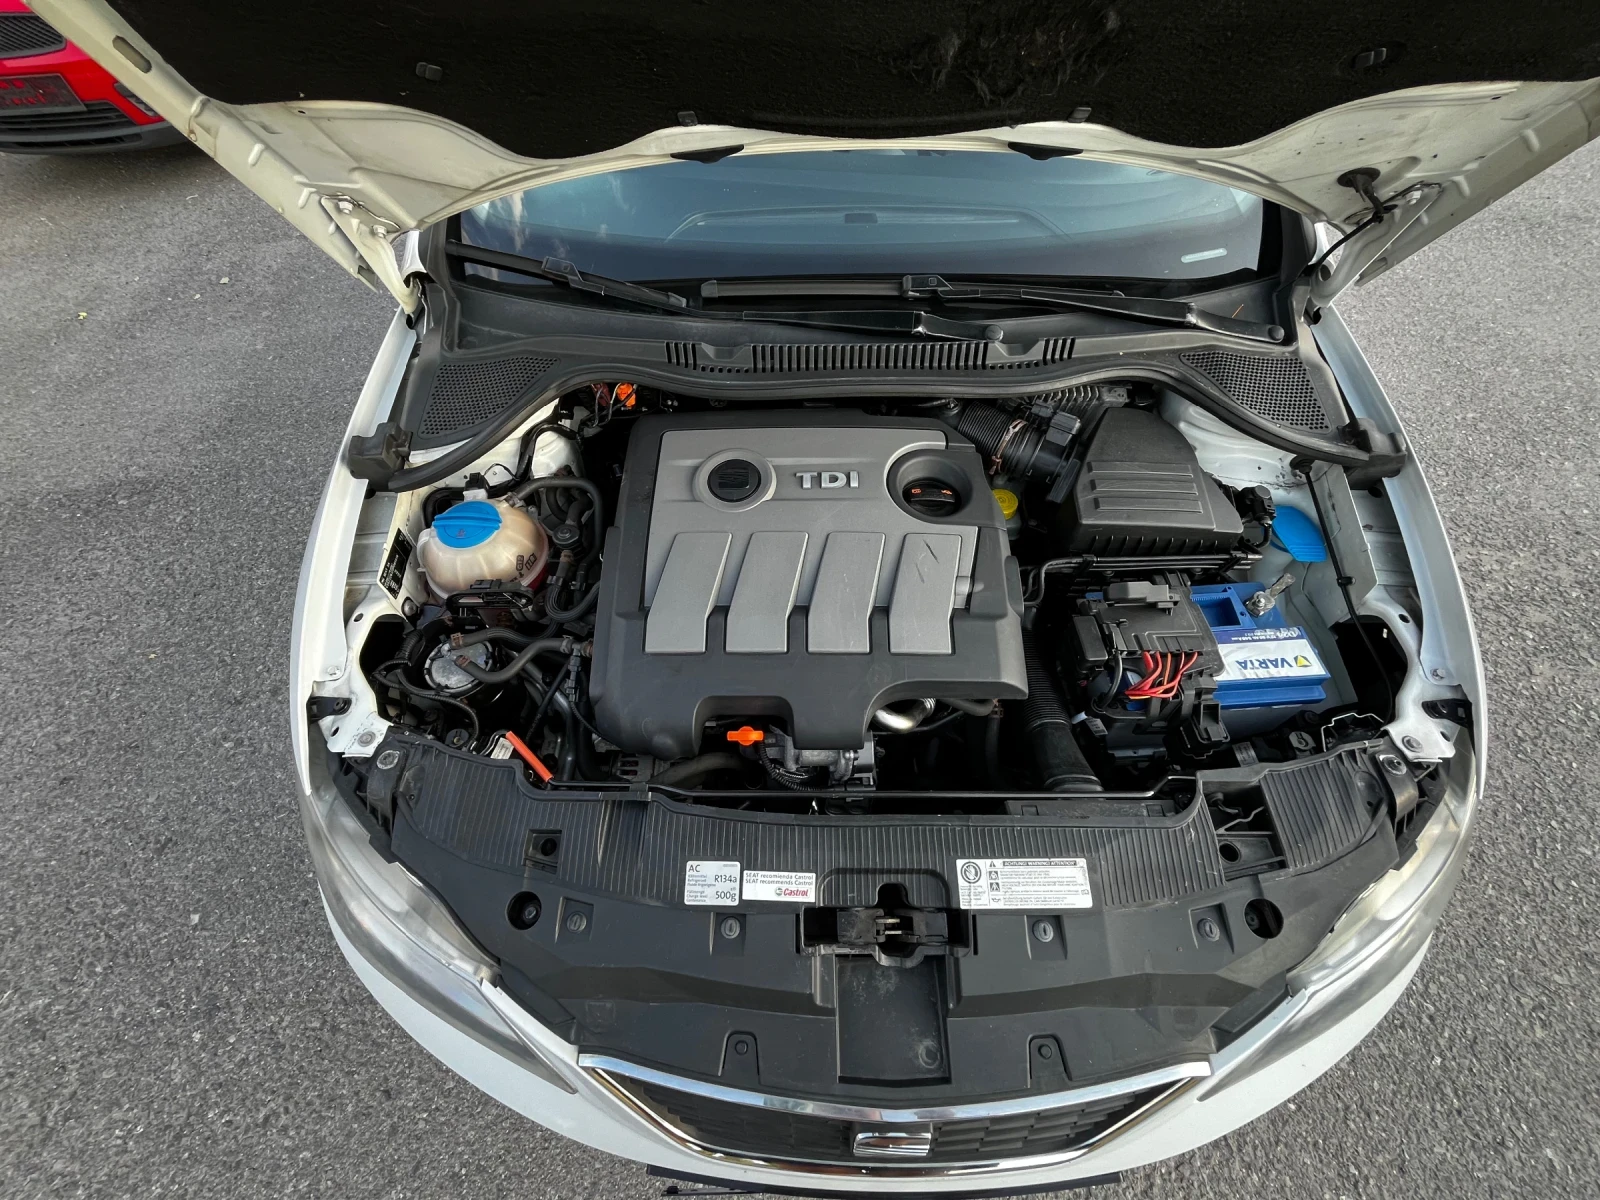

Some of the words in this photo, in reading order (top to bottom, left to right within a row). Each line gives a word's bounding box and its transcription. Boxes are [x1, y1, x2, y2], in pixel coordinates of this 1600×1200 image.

[795, 470, 859, 490] TDI
[1236, 657, 1293, 670] VARTA
[688, 864, 701, 873] AC
[714, 874, 738, 883] R134a
[715, 890, 737, 902] 500g
[783, 887, 809, 897] Castrol
